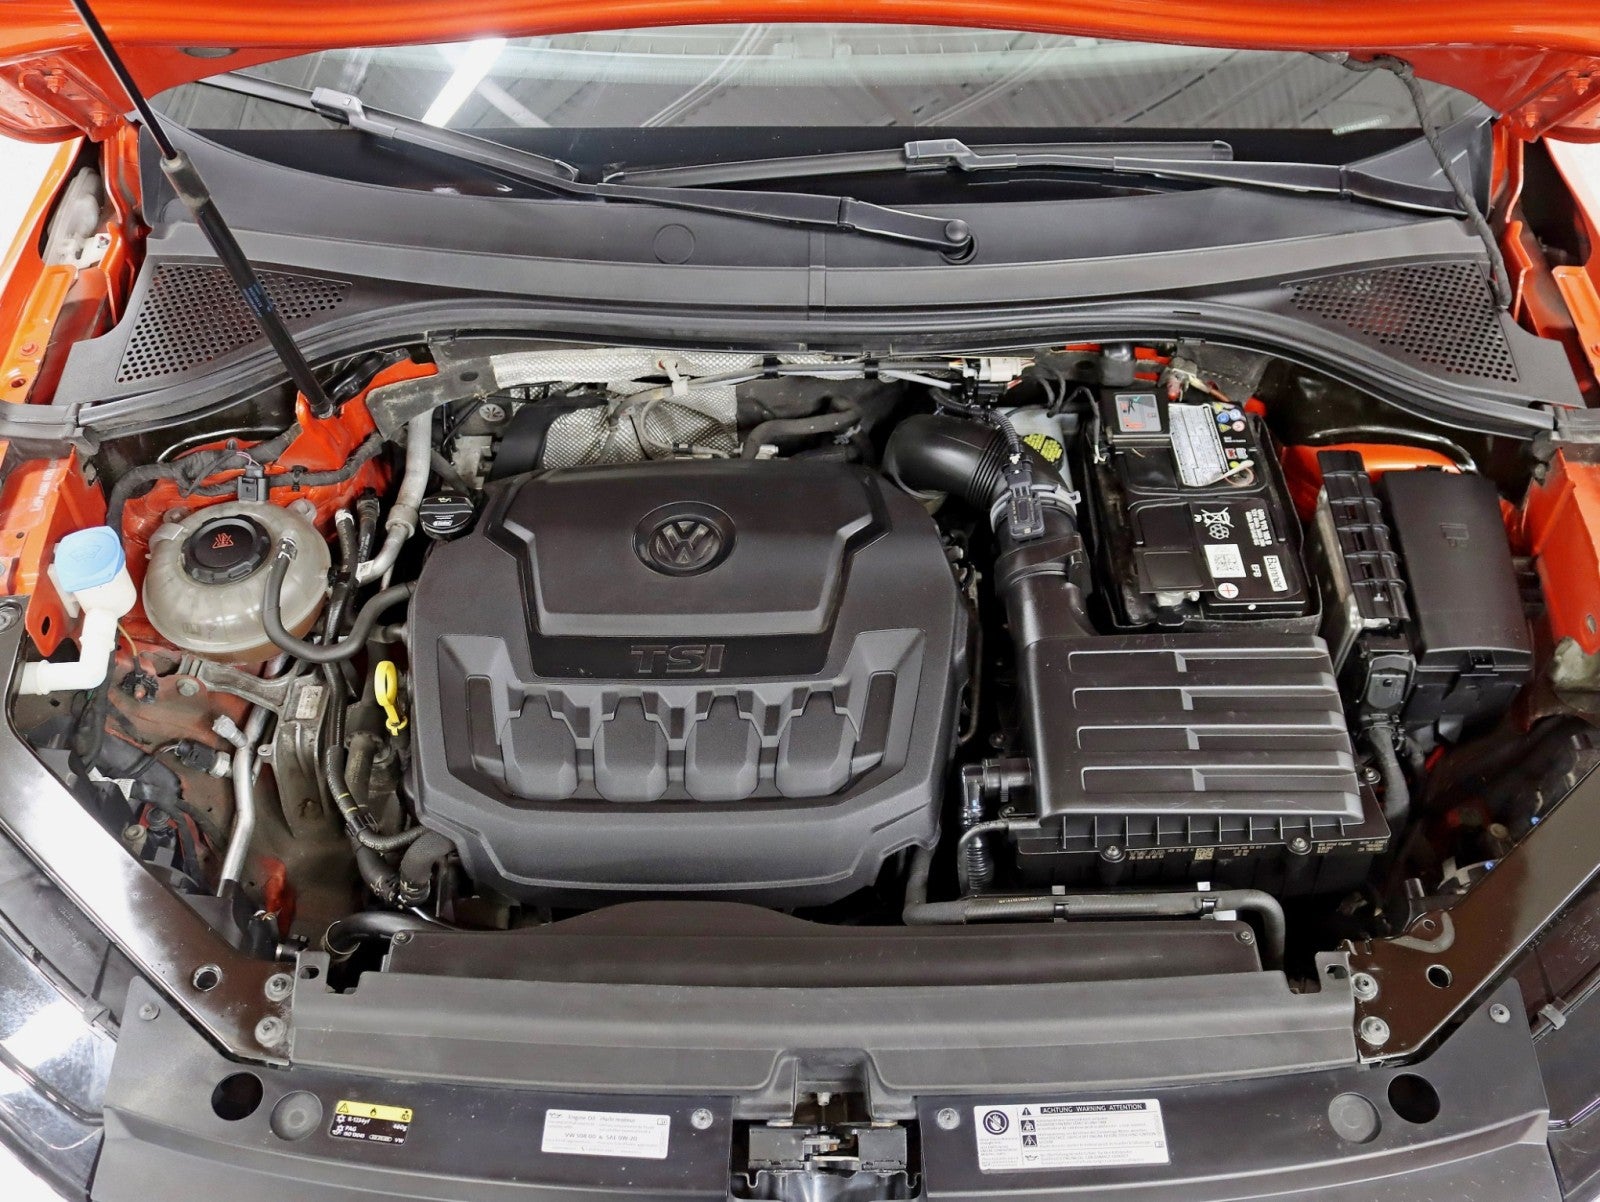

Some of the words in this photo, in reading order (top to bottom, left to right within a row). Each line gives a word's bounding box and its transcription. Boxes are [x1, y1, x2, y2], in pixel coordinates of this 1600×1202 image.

[652, 517, 721, 569] VW
[1266, 557, 1283, 589] Banner
[630, 644, 726, 674] TSI
[1042, 1106, 1073, 1114] ACHTUNG
[1108, 1103, 1143, 1111] ATTENTION
